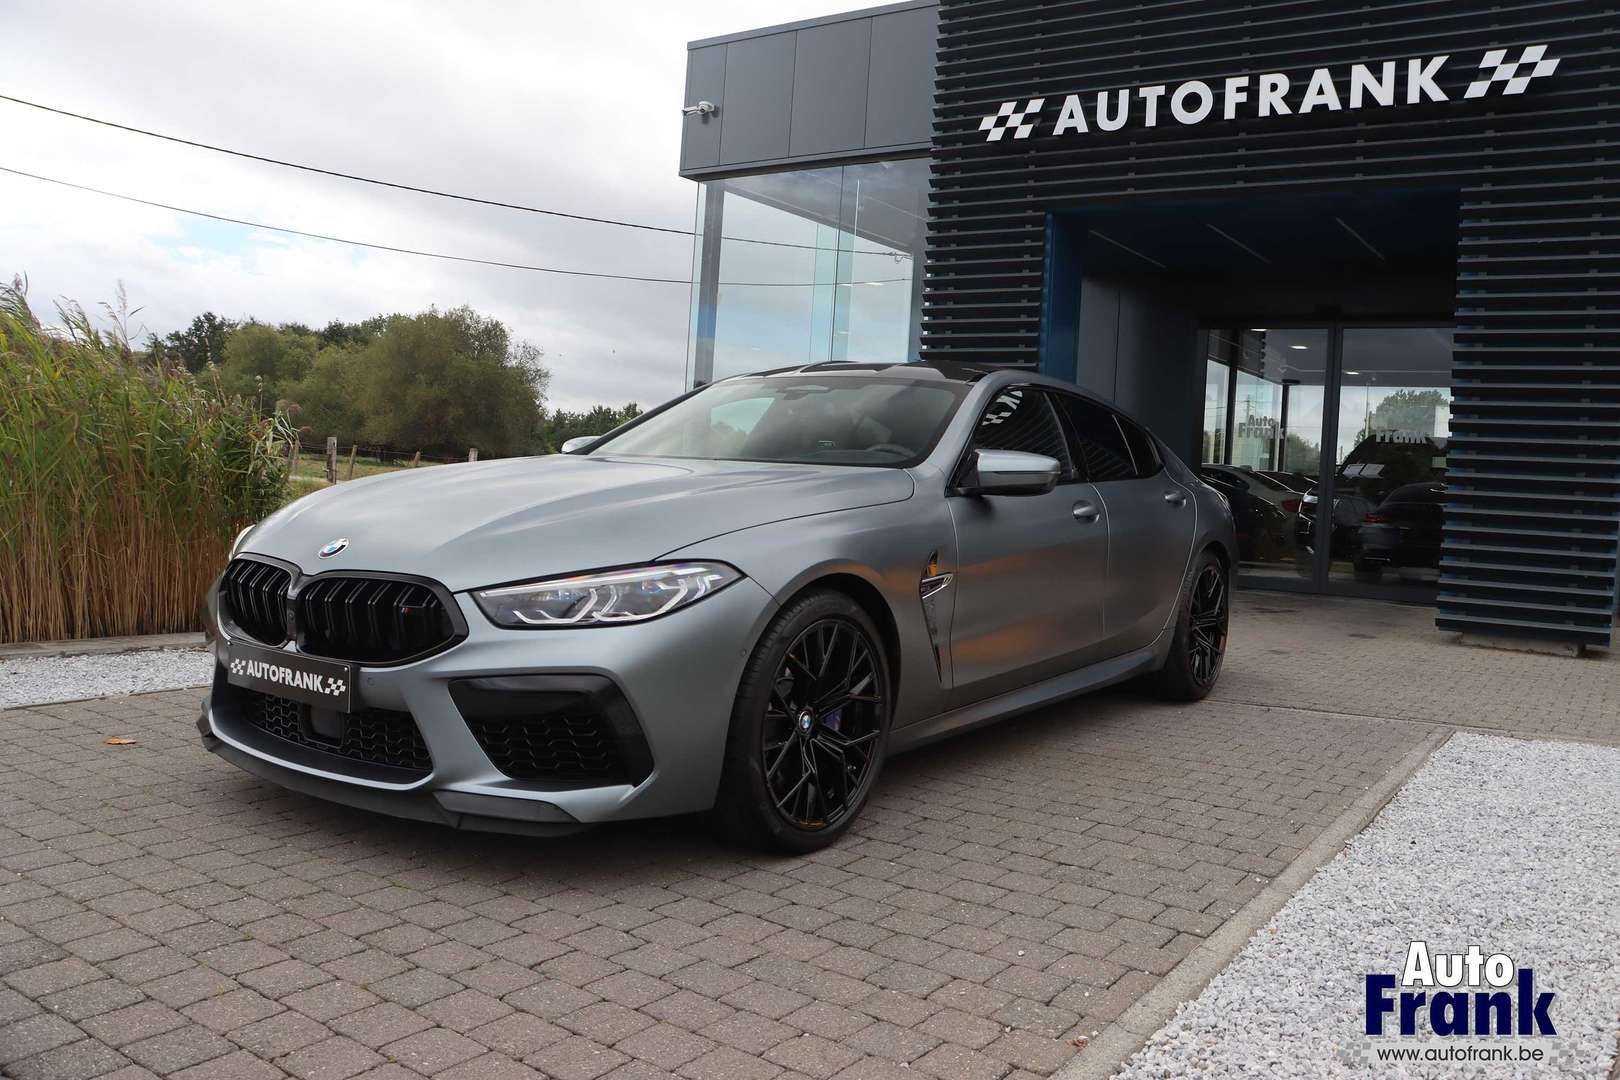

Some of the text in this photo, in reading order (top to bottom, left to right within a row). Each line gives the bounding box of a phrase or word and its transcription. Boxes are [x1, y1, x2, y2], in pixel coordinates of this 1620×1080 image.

[1052, 55, 1450, 136] AUTOFRANK
[1248, 414, 1275, 427] Auto
[247, 660, 323, 693] AUTOFRANK
